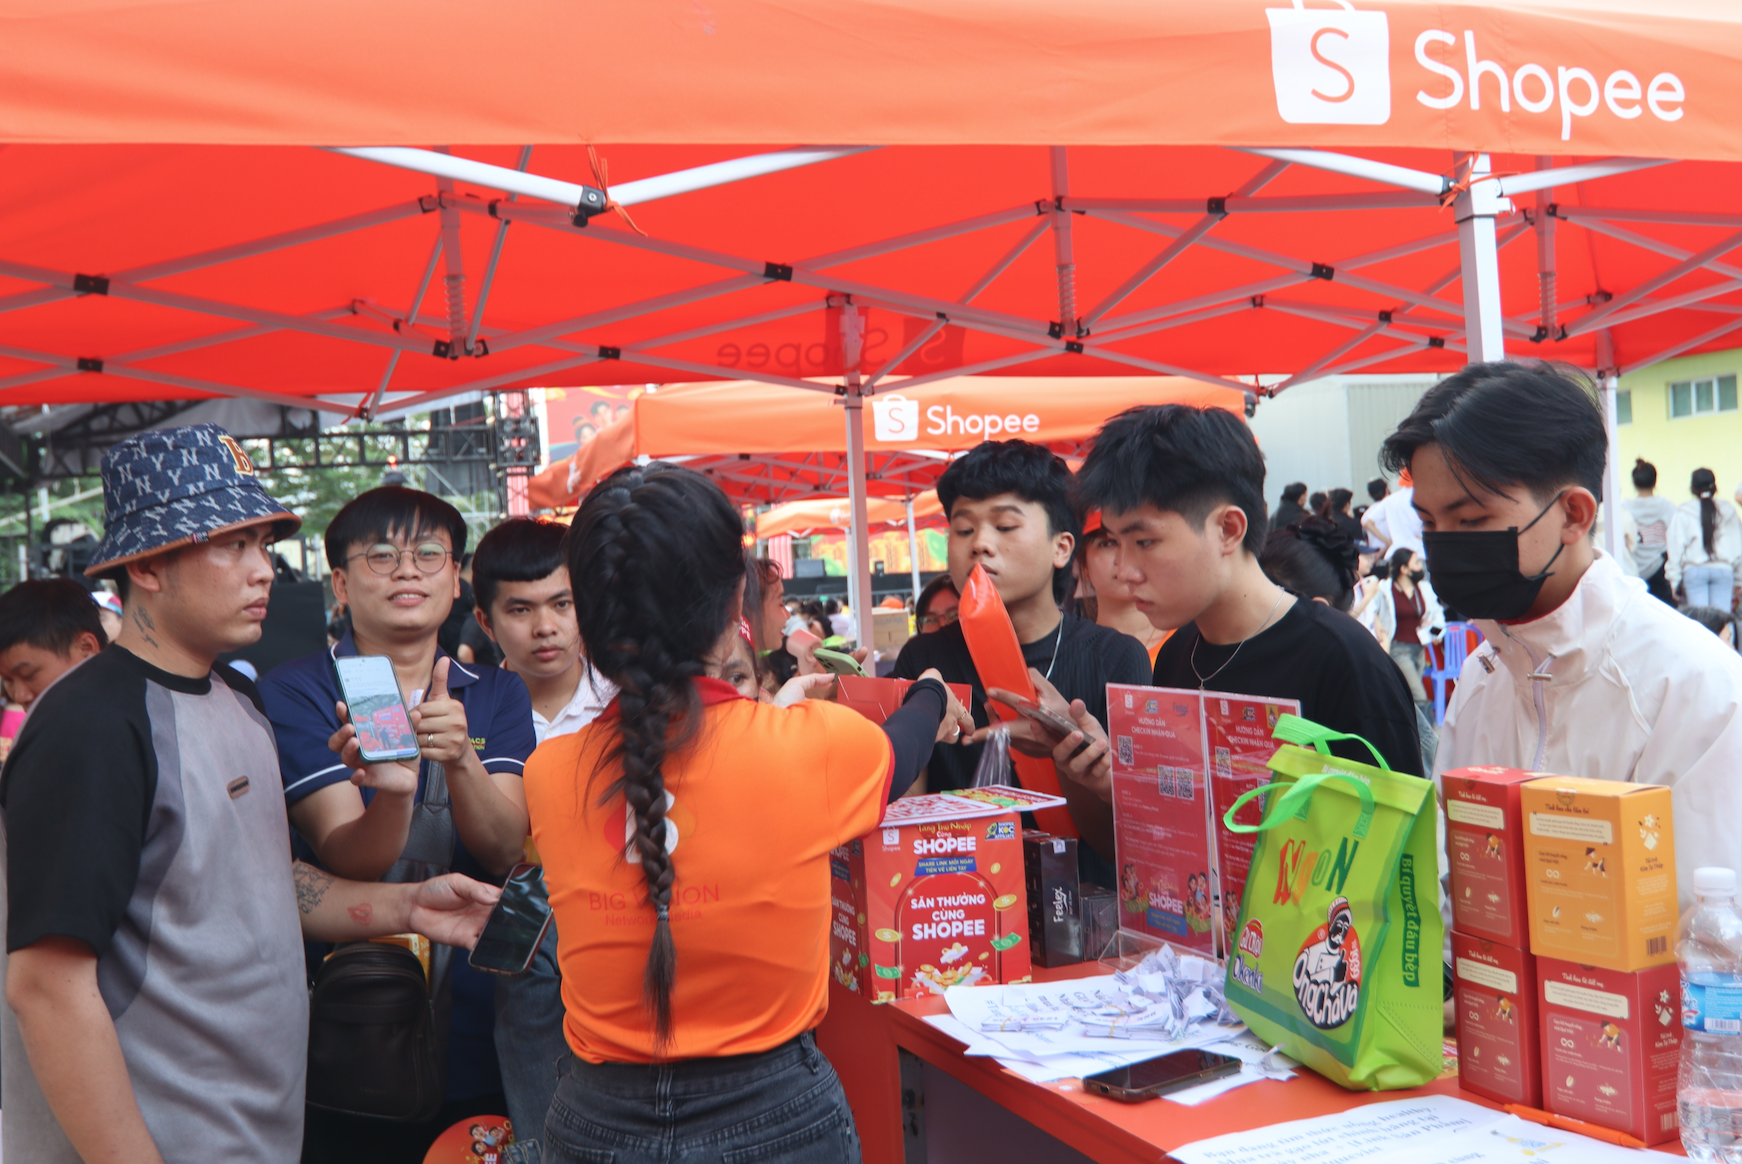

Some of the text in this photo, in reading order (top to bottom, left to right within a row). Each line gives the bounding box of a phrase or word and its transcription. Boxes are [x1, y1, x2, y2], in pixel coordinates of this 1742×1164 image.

[1414, 29, 1685, 140] Shopee
[926, 405, 1040, 441] Shopee
[218, 435, 254, 476] B
[882, 845, 901, 853] Shopee
[913, 836, 977, 855] SHOPEE
[1401, 857, 1413, 873] Bí
[588, 892, 626, 911] BIG
[1149, 891, 1184, 915] SHOPEE
[932, 908, 965, 922] CÙNG
[832, 920, 857, 947] SHOPEE
[912, 919, 985, 941] SHOPEE
